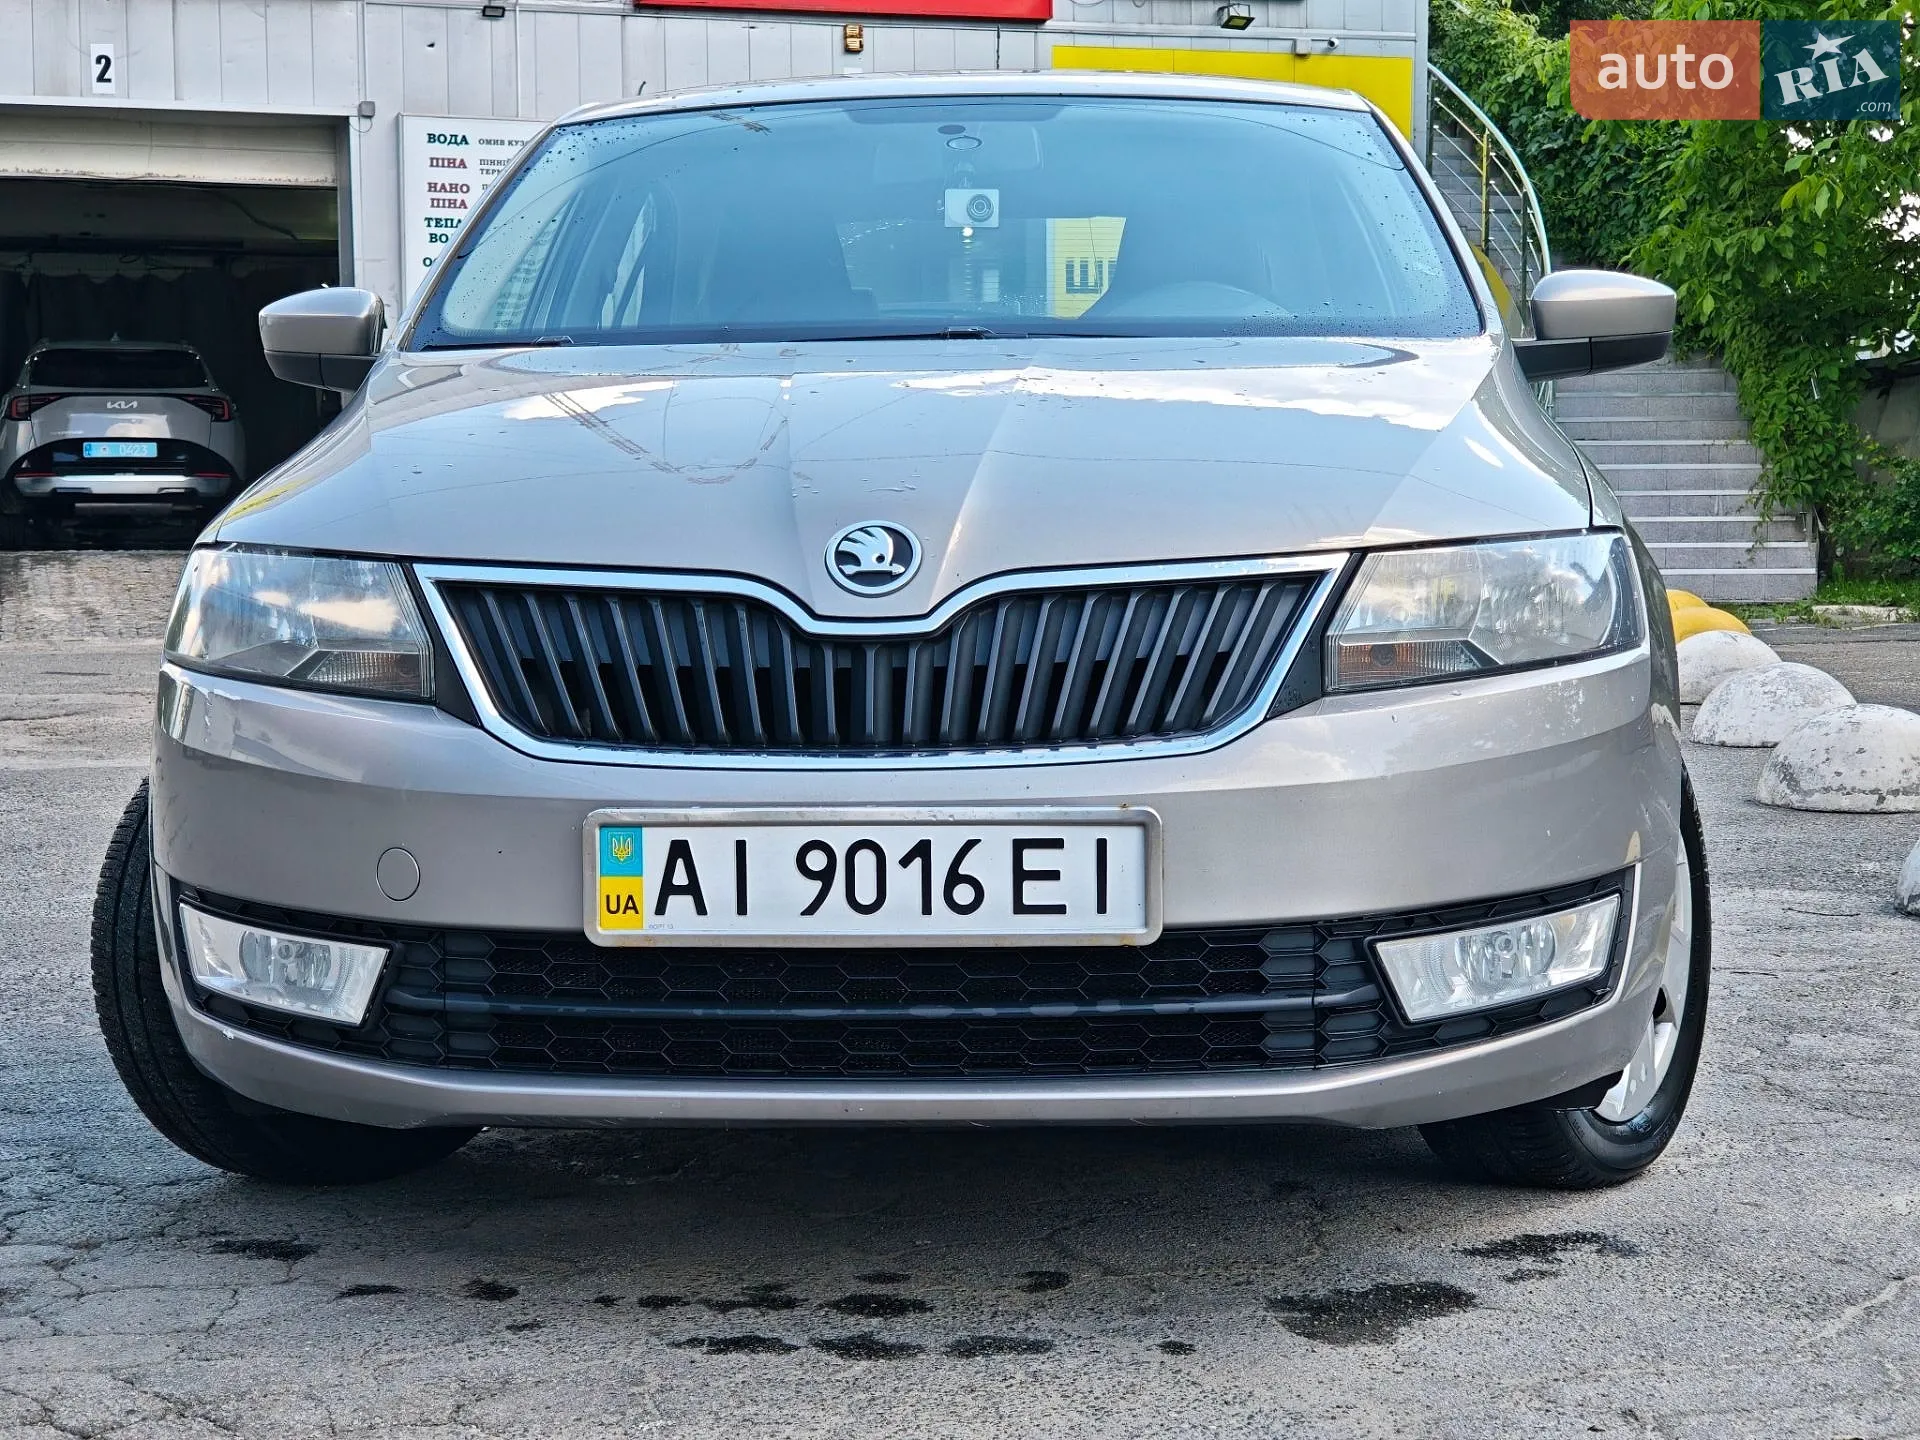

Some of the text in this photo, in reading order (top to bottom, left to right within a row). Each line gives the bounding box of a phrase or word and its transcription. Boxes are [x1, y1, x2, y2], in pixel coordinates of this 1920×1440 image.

[95, 54, 112, 83] 2
[427, 133, 469, 146] ВОДА
[429, 157, 467, 169] ПІНА
[427, 182, 470, 194] НАНО
[430, 198, 468, 209] ПІНА
[654, 837, 1108, 916] AI 9016 EI
[605, 894, 640, 915] UA
